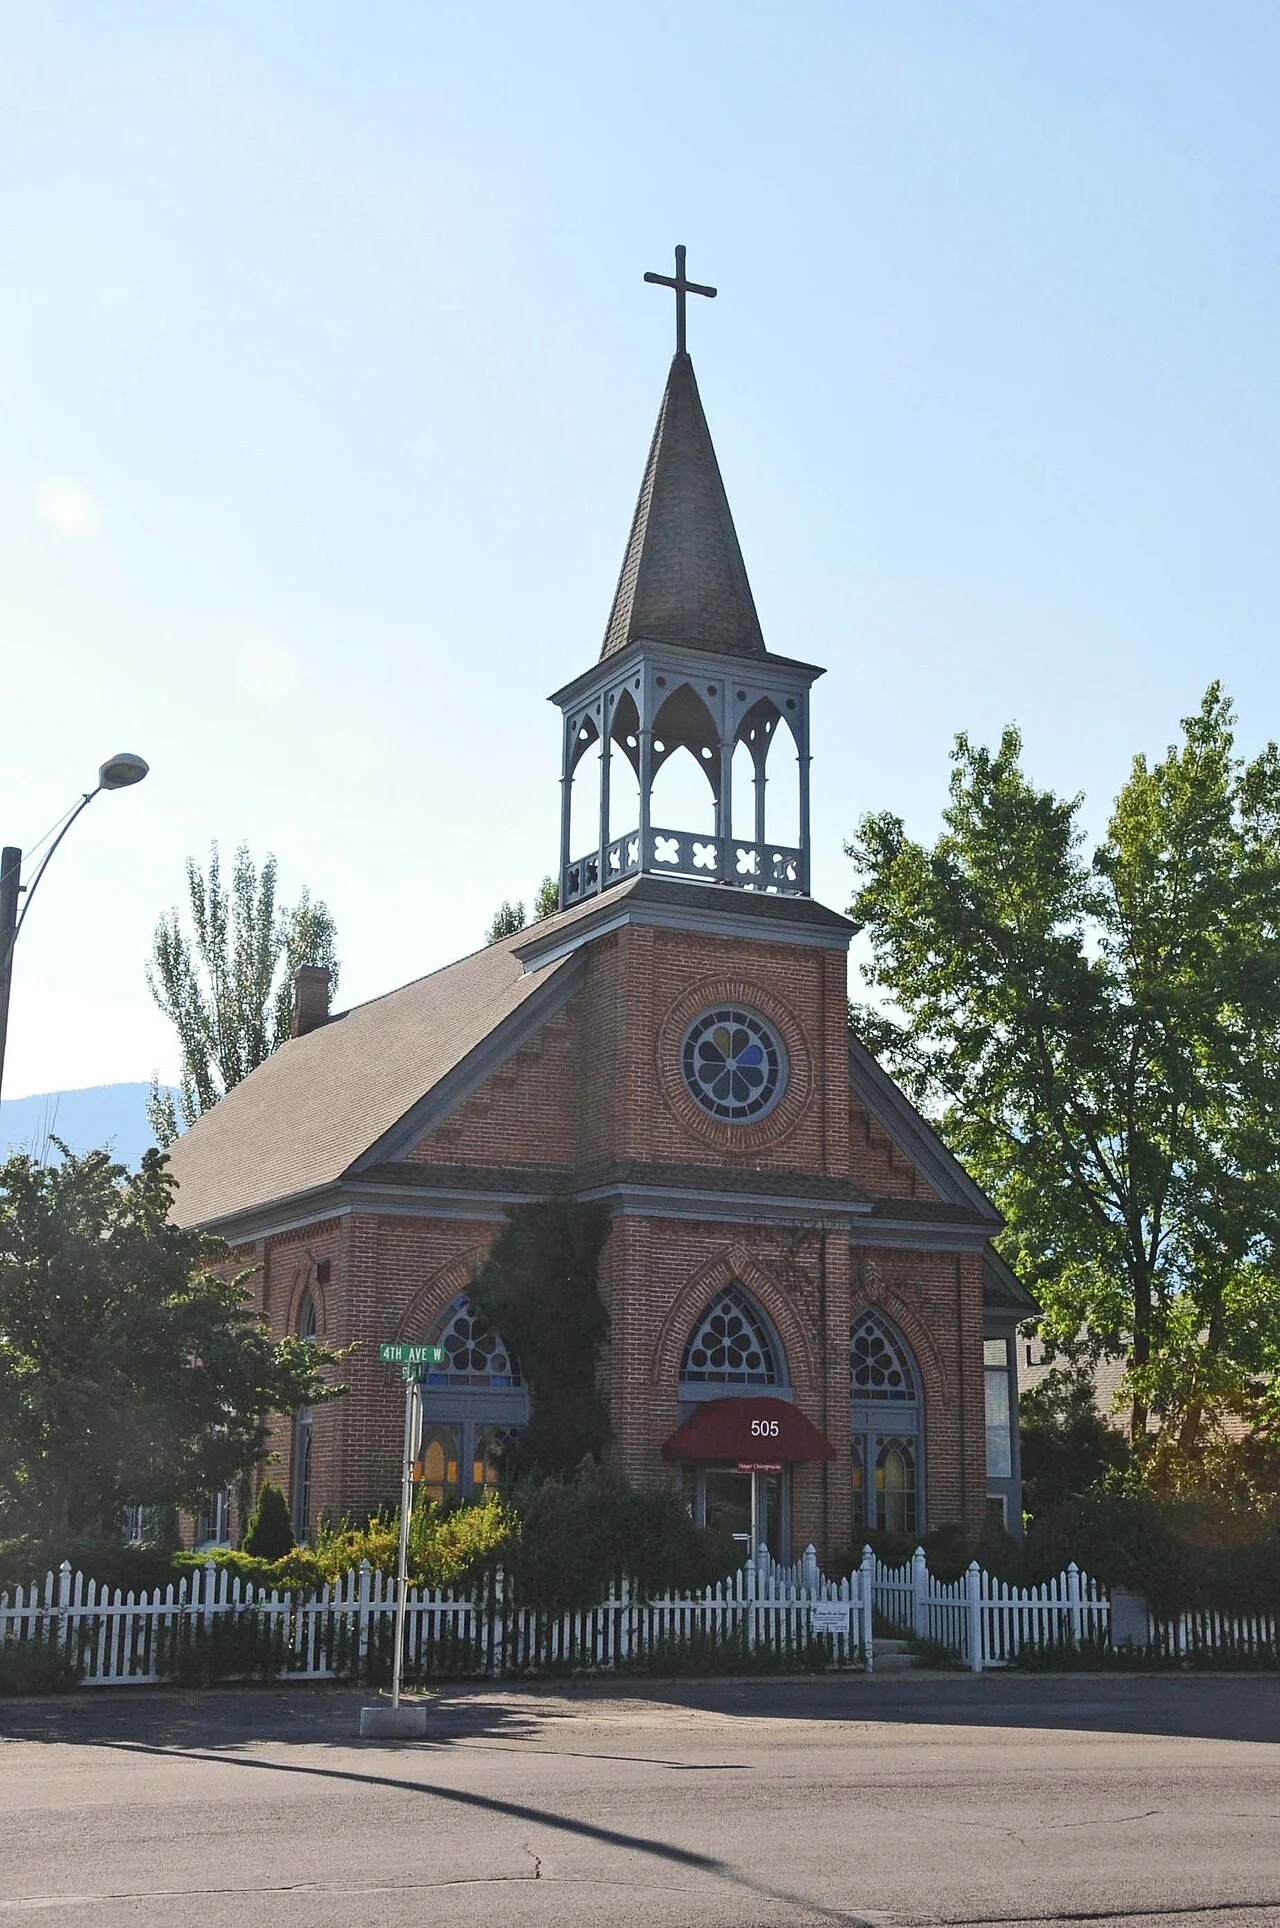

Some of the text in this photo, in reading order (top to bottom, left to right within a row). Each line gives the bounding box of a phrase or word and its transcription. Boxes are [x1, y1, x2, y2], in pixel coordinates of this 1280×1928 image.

[383, 1346, 442, 1361] 4TH AVE W
[751, 1420, 779, 1437] 505
